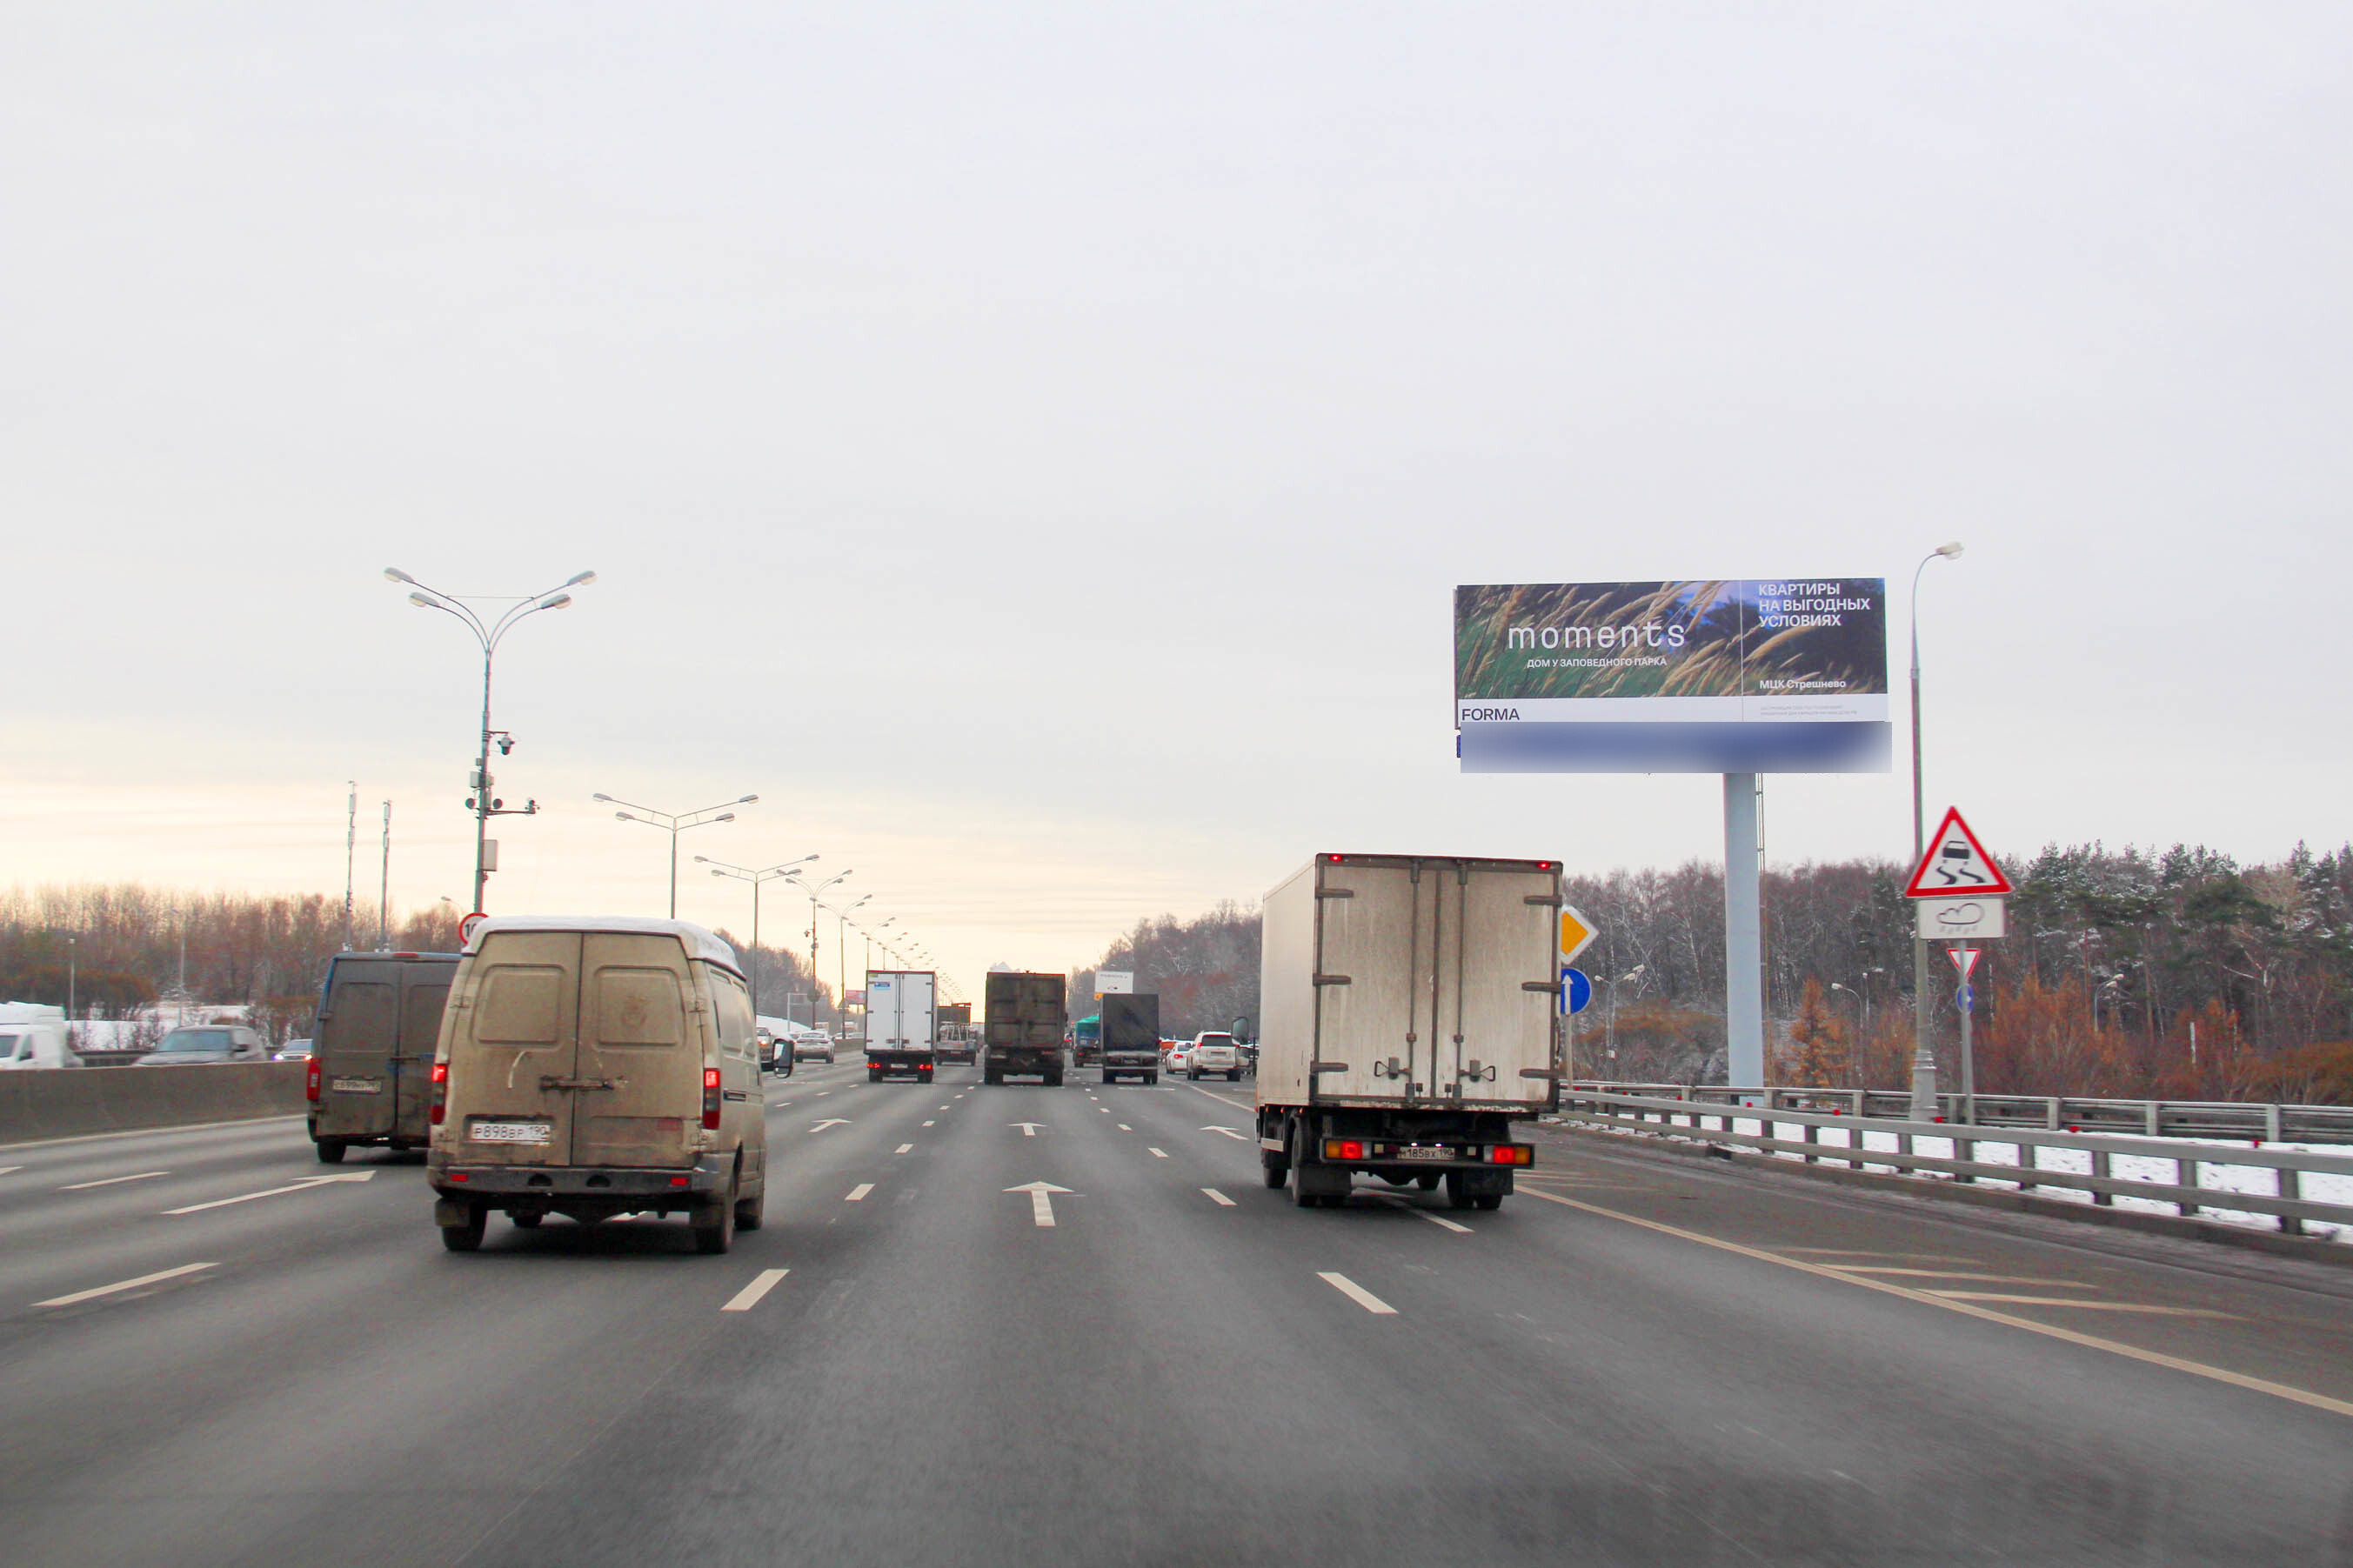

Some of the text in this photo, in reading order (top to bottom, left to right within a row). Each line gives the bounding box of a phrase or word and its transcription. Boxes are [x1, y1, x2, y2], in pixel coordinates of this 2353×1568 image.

[1759, 583, 1841, 597] КВАРТИРЫ
[1759, 597, 1870, 613] НА ВЫГОДНЫХ
[1759, 614, 1842, 627] УСЛОВИЯХ
[1508, 621, 1685, 649] moments
[1527, 657, 1668, 669] ДОМ У ЗАПОВЕДНОГО ПАРКА
[1760, 679, 1847, 691] МЦК Стрешнево
[1461, 708, 1521, 721] FORMA
